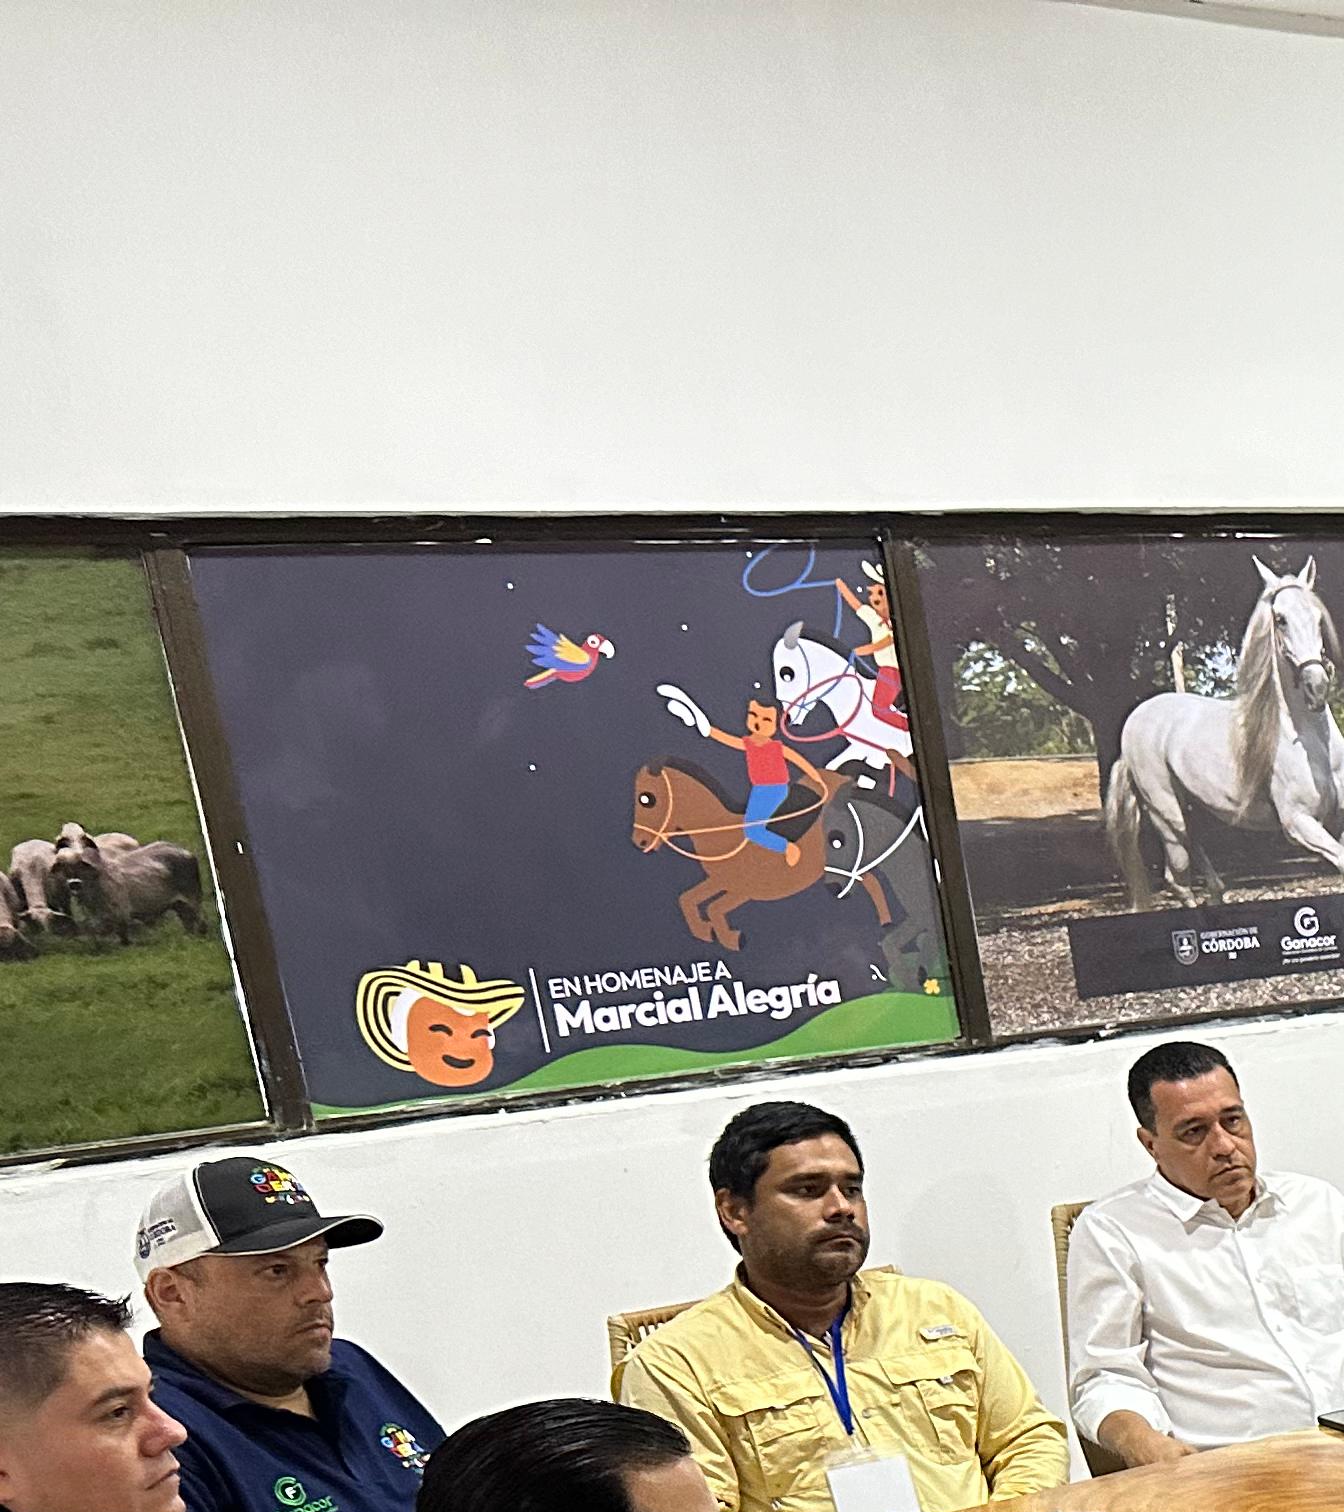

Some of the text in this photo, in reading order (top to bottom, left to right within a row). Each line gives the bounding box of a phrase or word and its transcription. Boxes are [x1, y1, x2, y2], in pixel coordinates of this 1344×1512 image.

[1201, 936, 1260, 954] CÓRDOBA
[1280, 935, 1337, 951] Ganacor
[548, 960, 731, 999] EN HOMENAJE A
[553, 972, 842, 1037] Marcial Alegría
